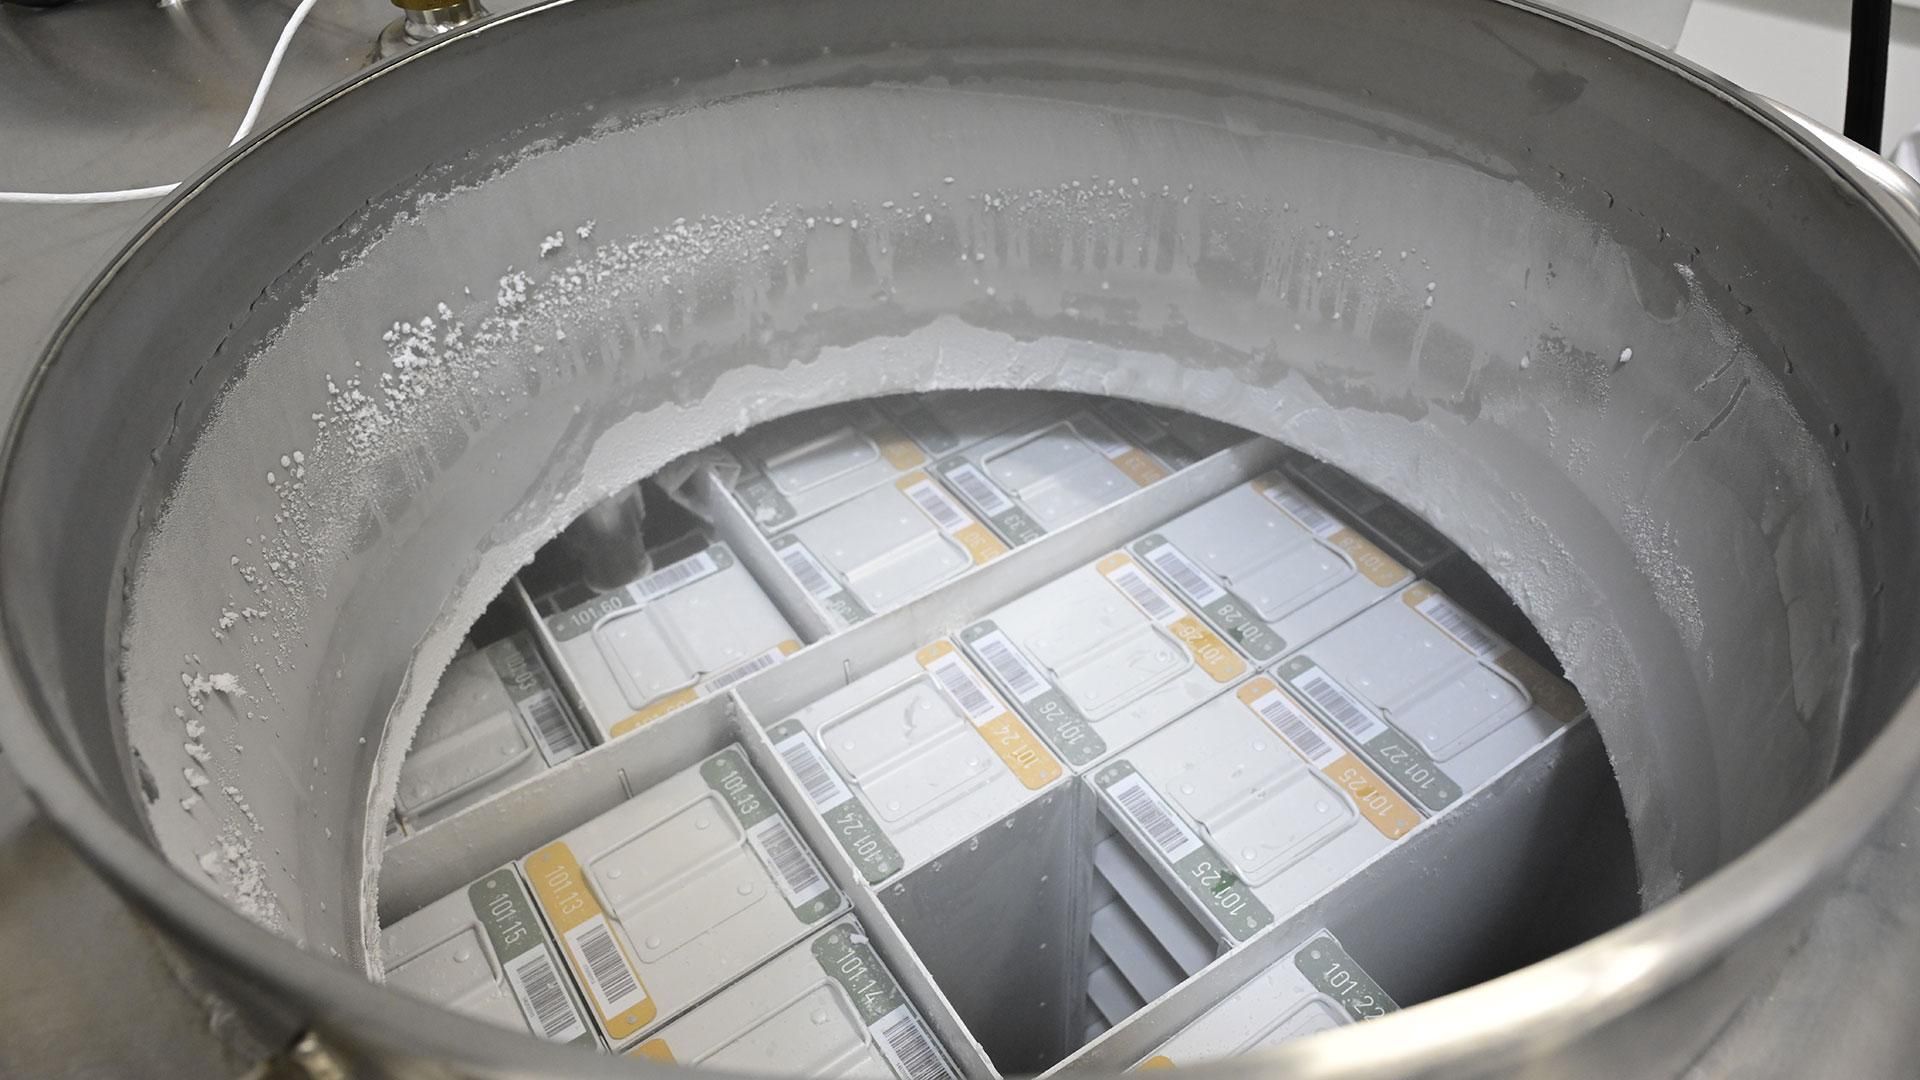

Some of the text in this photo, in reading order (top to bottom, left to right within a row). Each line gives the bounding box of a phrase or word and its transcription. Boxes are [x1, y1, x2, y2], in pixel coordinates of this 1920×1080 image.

[1005, 514, 1039, 541] 01.33
[1179, 625, 1222, 665] 101.26
[1218, 604, 1263, 642] 101.28
[1040, 701, 1084, 745] 101.26
[1380, 745, 1435, 789] 101.27
[722, 770, 760, 815] 101.13
[1339, 768, 1393, 816] 101.25
[838, 813, 881, 862] 101.24
[545, 866, 583, 914] 101.13
[1191, 861, 1247, 916] 101.25
[489, 893, 527, 944] 101.15
[836, 947, 884, 1005] 101.14
